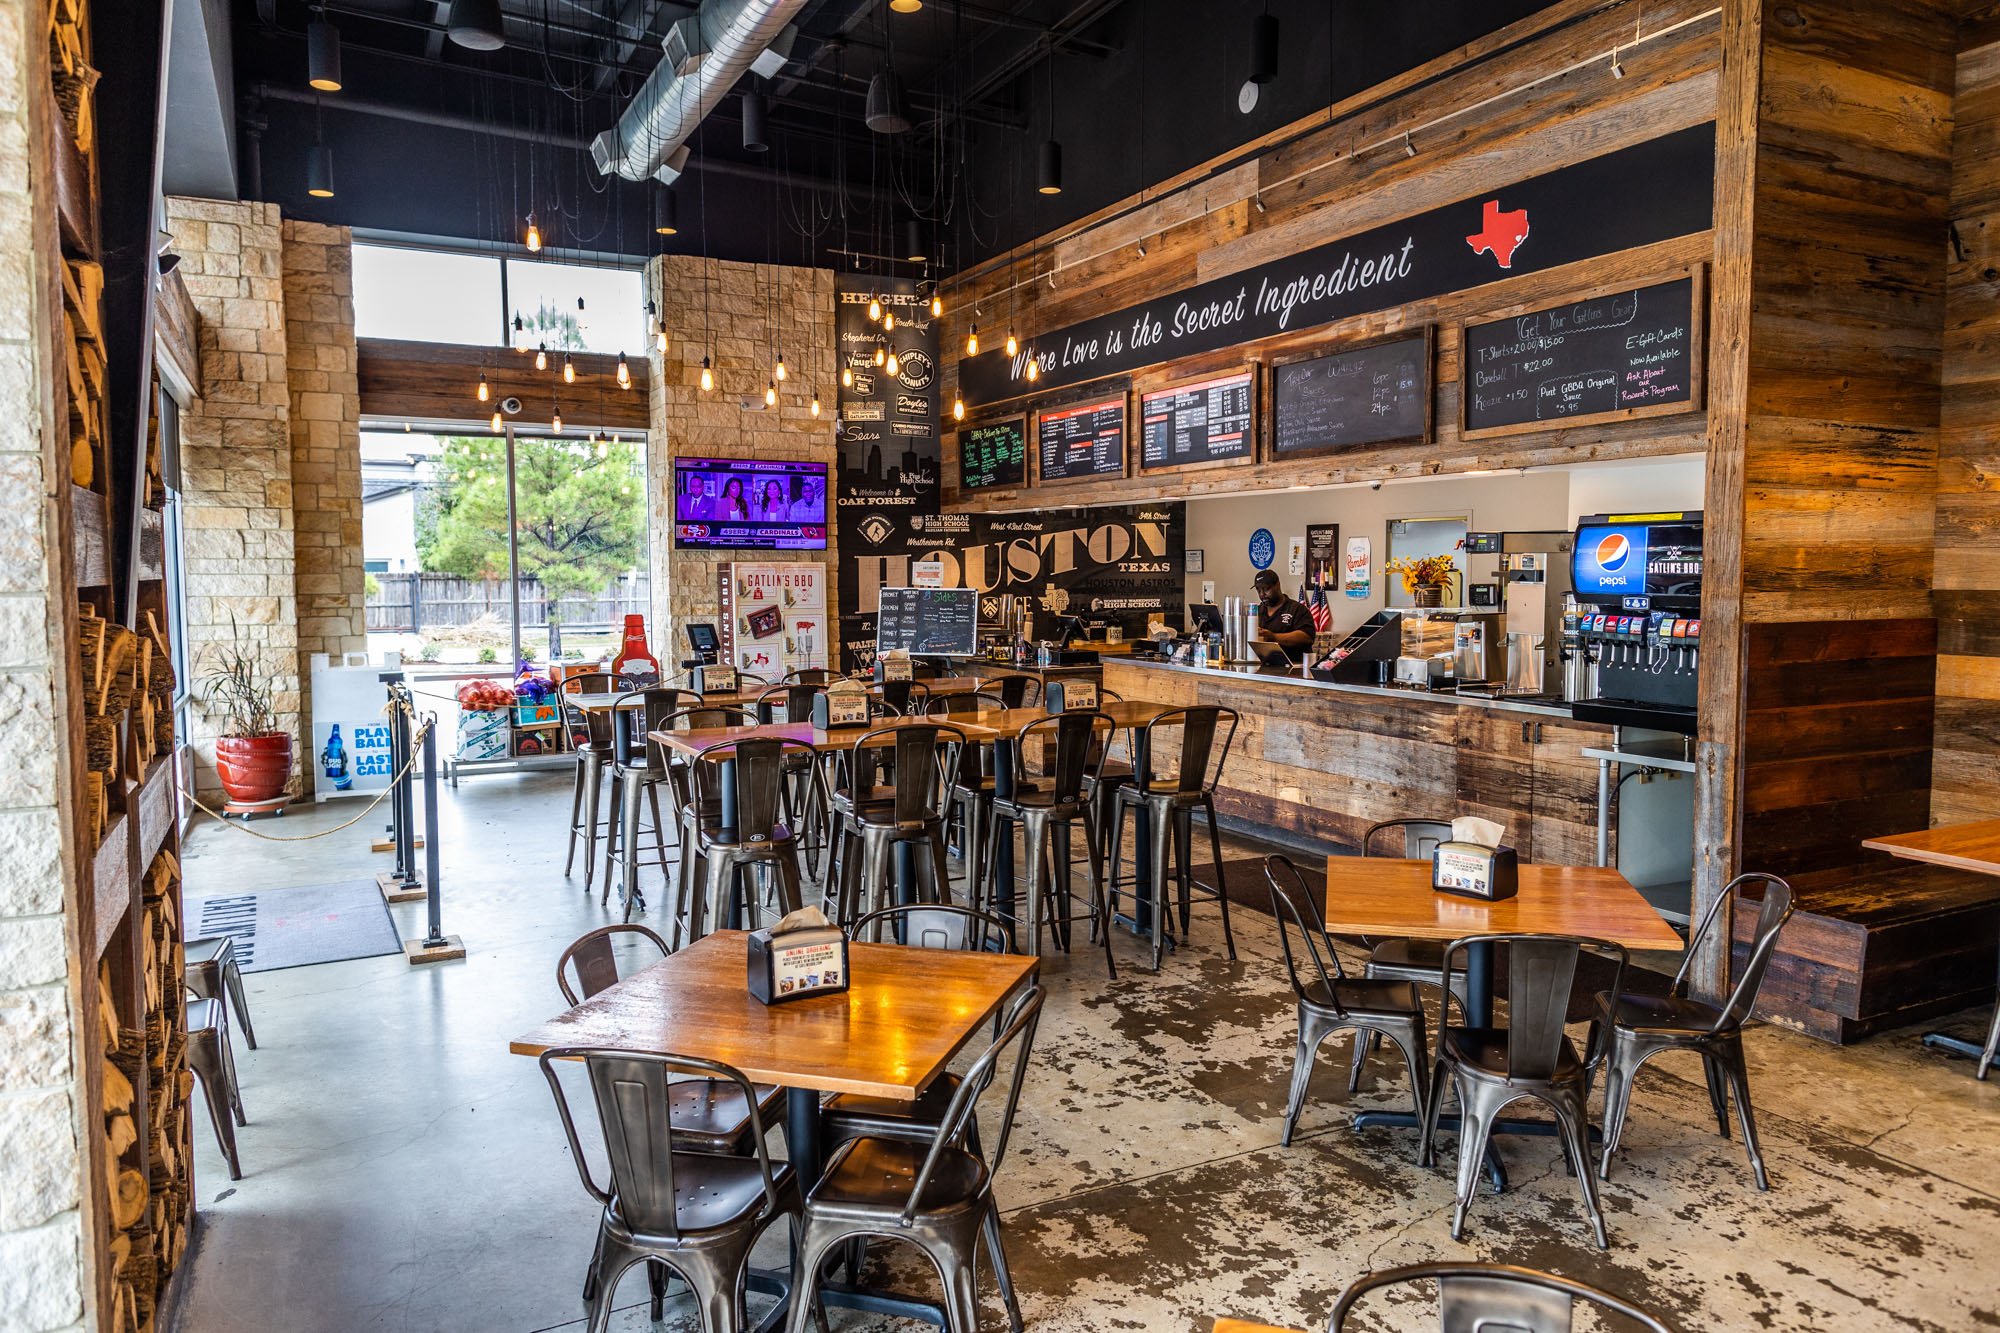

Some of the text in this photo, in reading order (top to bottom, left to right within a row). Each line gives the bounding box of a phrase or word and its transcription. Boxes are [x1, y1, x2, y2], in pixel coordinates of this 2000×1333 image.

[841, 292, 931, 306] HEGHTS
[1011, 236, 1414, 382] Whre Love is the Secret Ingredient
[1520, 316, 1540, 339] Get
[1549, 312, 1567, 329] Your
[1612, 300, 1633, 318] Gear
[842, 332, 875, 343] Shepherd
[1656, 328, 1684, 344] Cards
[899, 352, 932, 369] SHIPLEY'S
[1645, 348, 1681, 365] Available
[1476, 367, 1506, 388] Baseball
[1523, 357, 1553, 373] $22.00
[1627, 367, 1667, 382] Ask About
[899, 372, 930, 388] DONUTS
[1540, 376, 1616, 398] Pint GBBQ Original
[1563, 393, 1582, 402] Sauce
[1622, 384, 1680, 402] Rewards Program
[898, 396, 928, 408] Doyle's
[1371, 402, 1391, 416] 24pc
[843, 426, 880, 441] Sears
[859, 487, 887, 496] Welcome
[838, 497, 917, 506] OAK FOREST
[1153, 512, 1170, 520] Street
[990, 523, 1043, 531] West 43rd Street
[907, 537, 943, 546] Westheimer
[1118, 562, 1170, 573] TEXAS
[1649, 562, 1699, 574] GATLIN'S BBQ
[748, 574, 813, 587] GATLIN'S BBQ
[1599, 575, 1628, 587] pepsi
